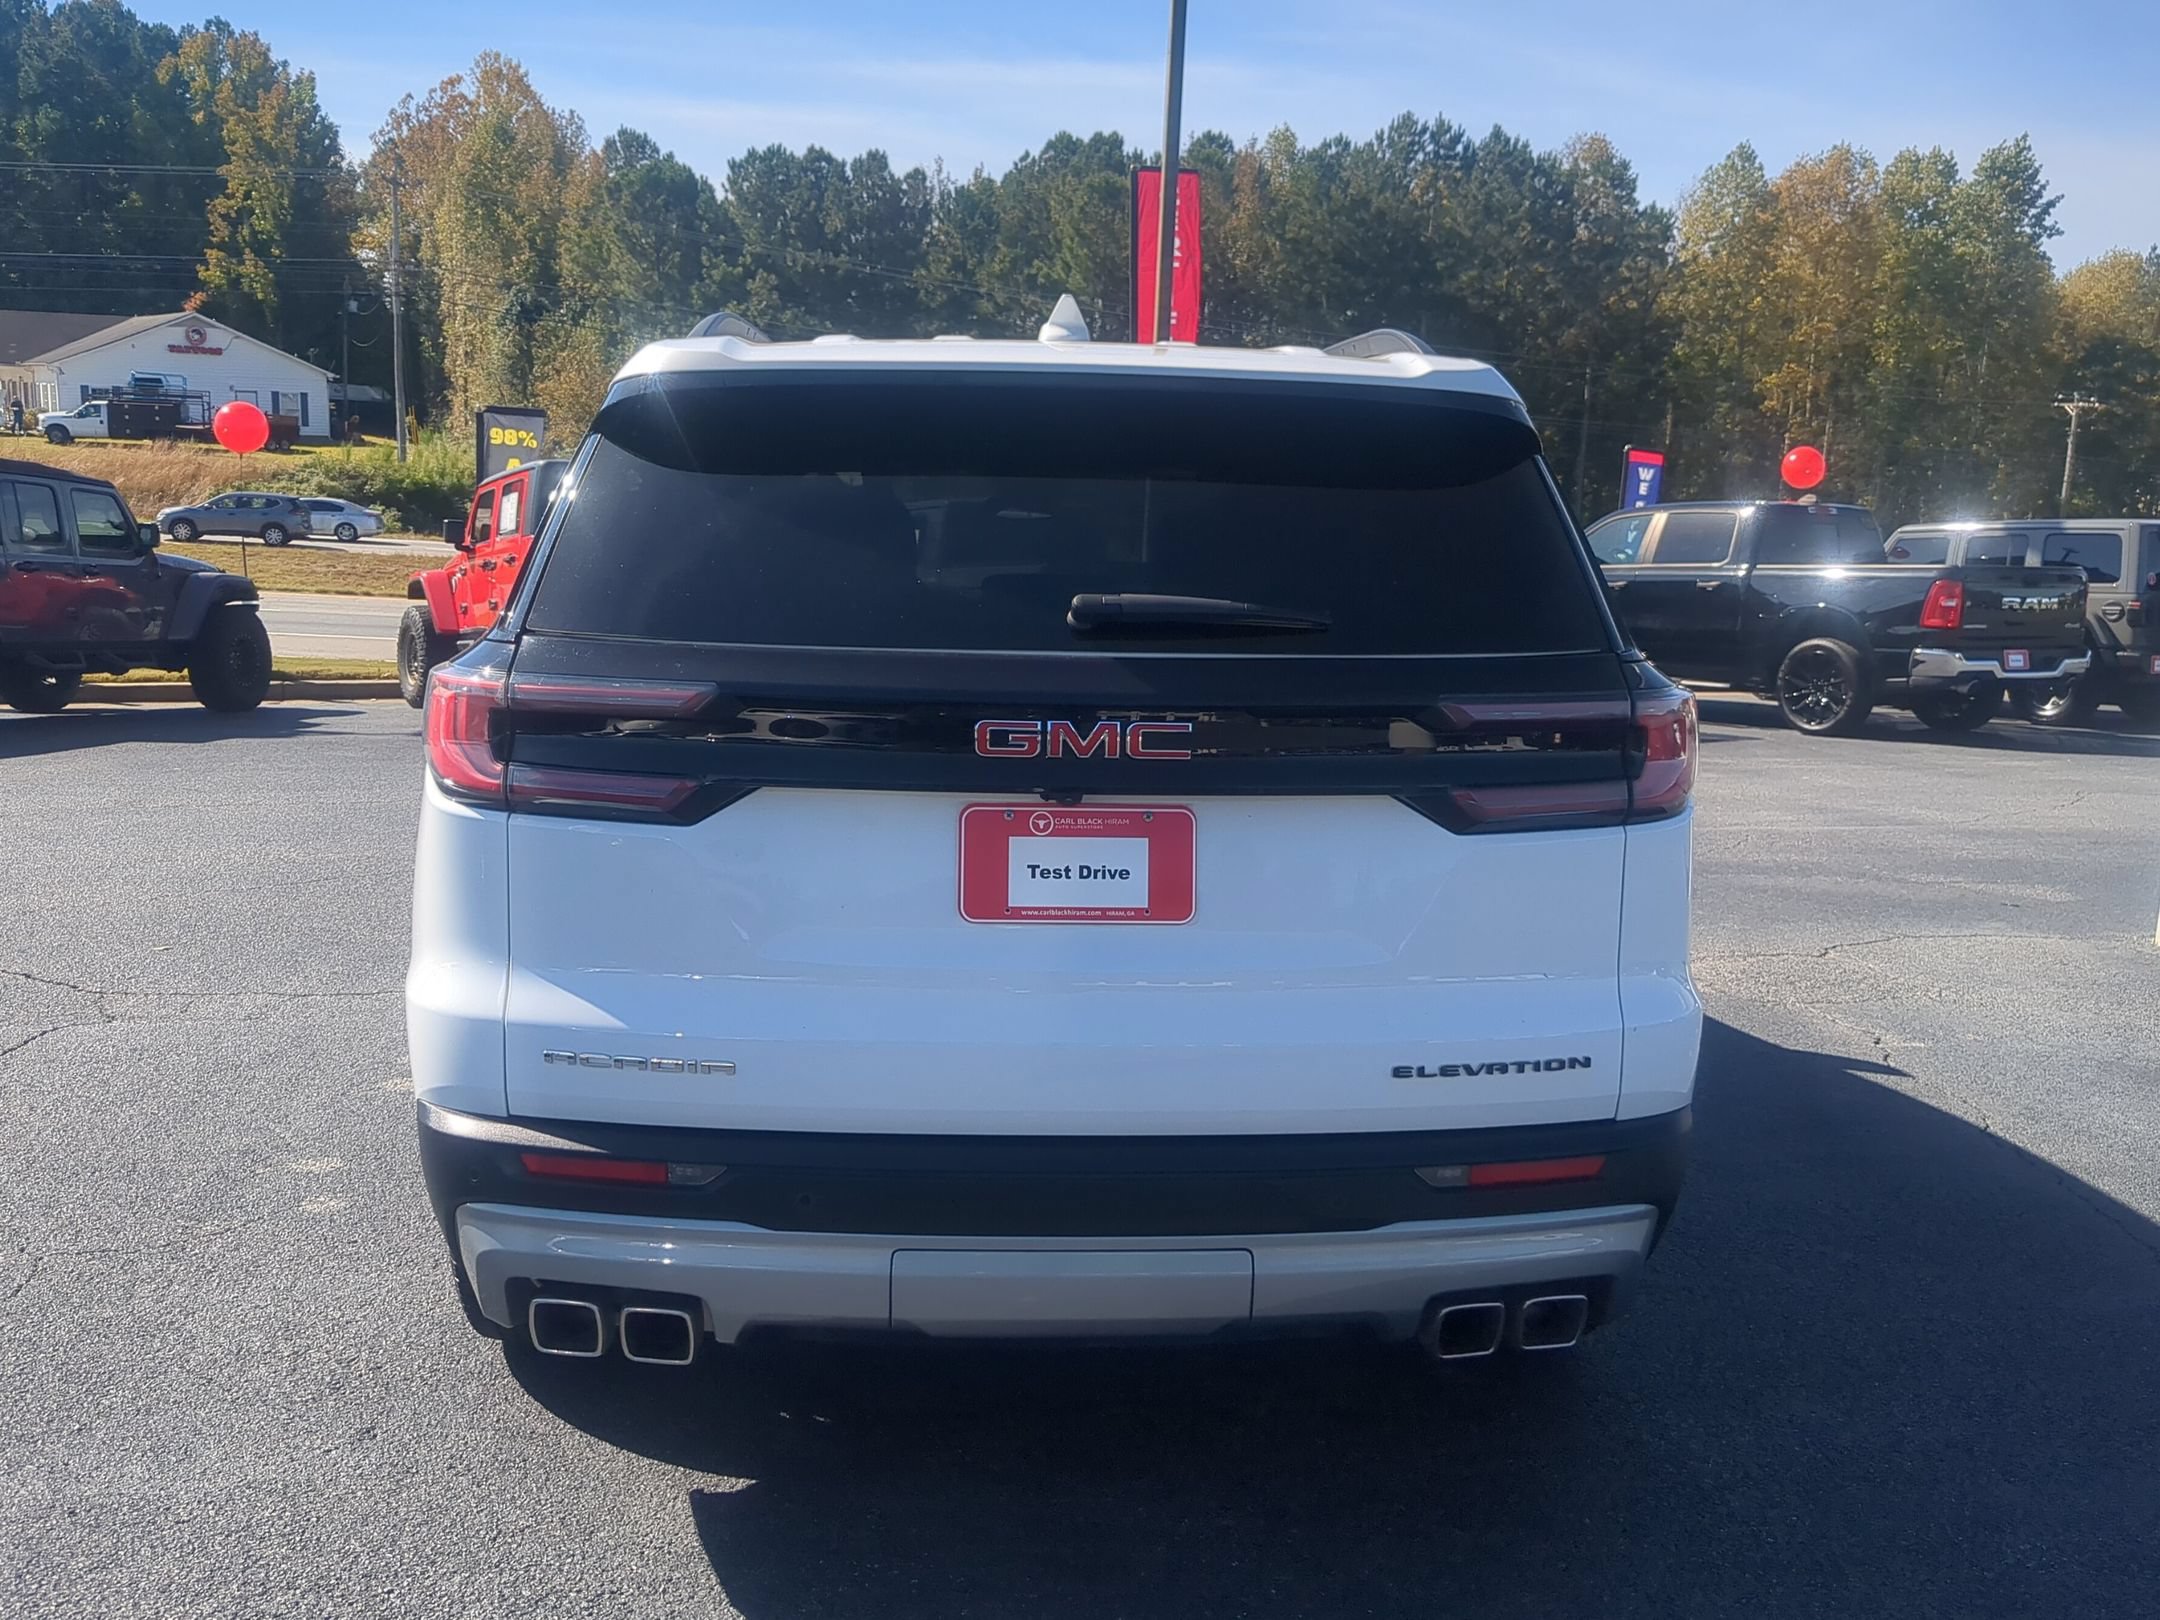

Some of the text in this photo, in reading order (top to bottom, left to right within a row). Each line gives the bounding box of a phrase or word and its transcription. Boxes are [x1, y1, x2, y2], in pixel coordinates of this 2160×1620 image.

[489, 427, 538, 449] 98%
[1638, 467, 1656, 495] WE
[2002, 597, 2059, 609] RAM
[974, 719, 1193, 759] GMC
[1054, 817, 1075, 825] CARL
[1027, 864, 1131, 880] Test Drive
[542, 1048, 736, 1075] ACADIA
[1391, 1056, 1592, 1078] ELEVATION
